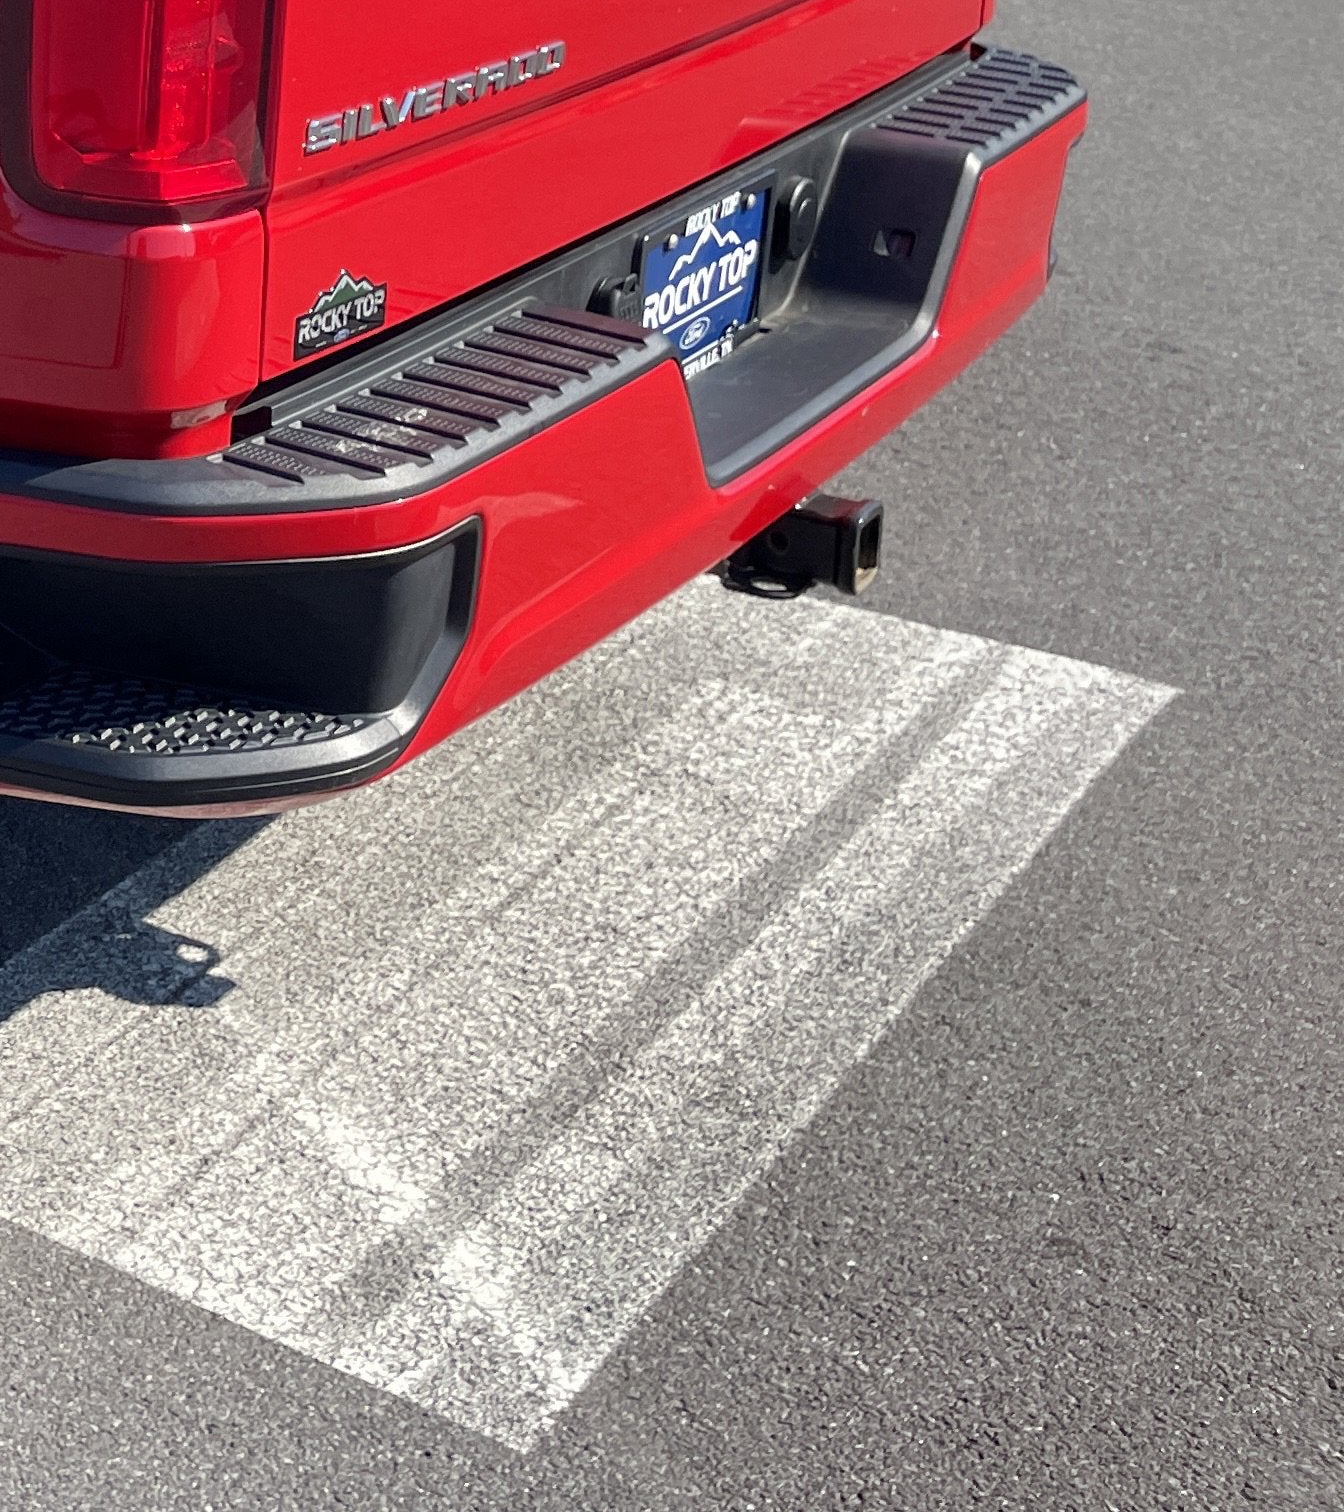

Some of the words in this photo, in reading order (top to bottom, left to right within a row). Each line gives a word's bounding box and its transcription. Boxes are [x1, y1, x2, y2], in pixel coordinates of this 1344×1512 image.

[303, 41, 565, 157] SILVERADO
[298, 301, 352, 344] ROCKY
[354, 289, 386, 319] TOP
[642, 261, 717, 330] ROCKY
[718, 239, 758, 292] TOP
